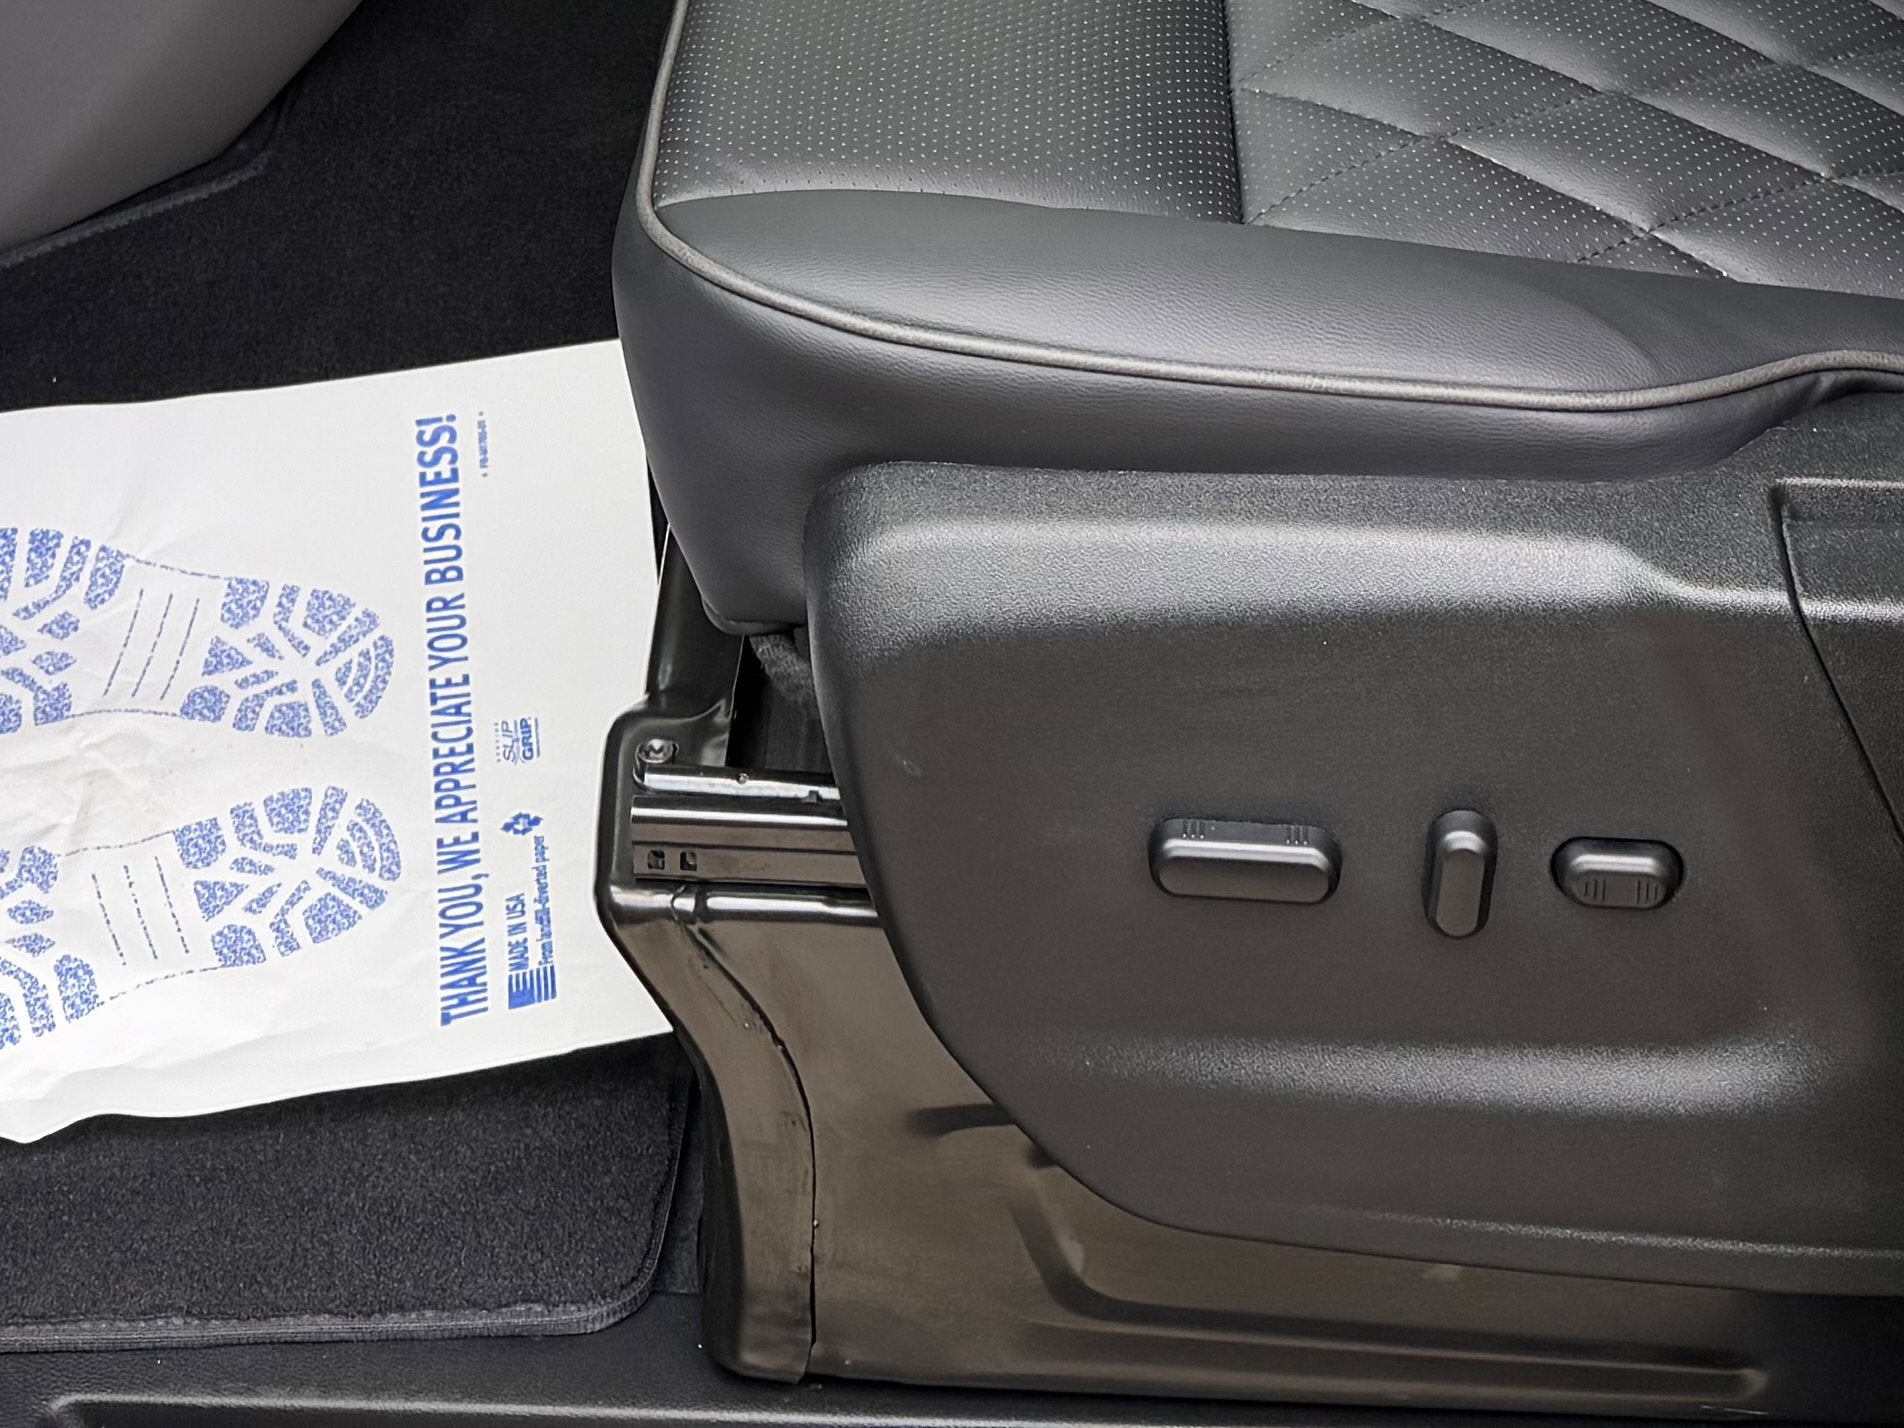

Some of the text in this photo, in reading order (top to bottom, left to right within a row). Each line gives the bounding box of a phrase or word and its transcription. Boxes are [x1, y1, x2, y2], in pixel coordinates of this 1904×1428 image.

[415, 413, 490, 1026] THANK YOU, WE APPRECIATE YOUR BUSINESS!
[534, 836, 550, 863] paper
[506, 893, 530, 972] MADE IN USA
[537, 941, 553, 966] From
